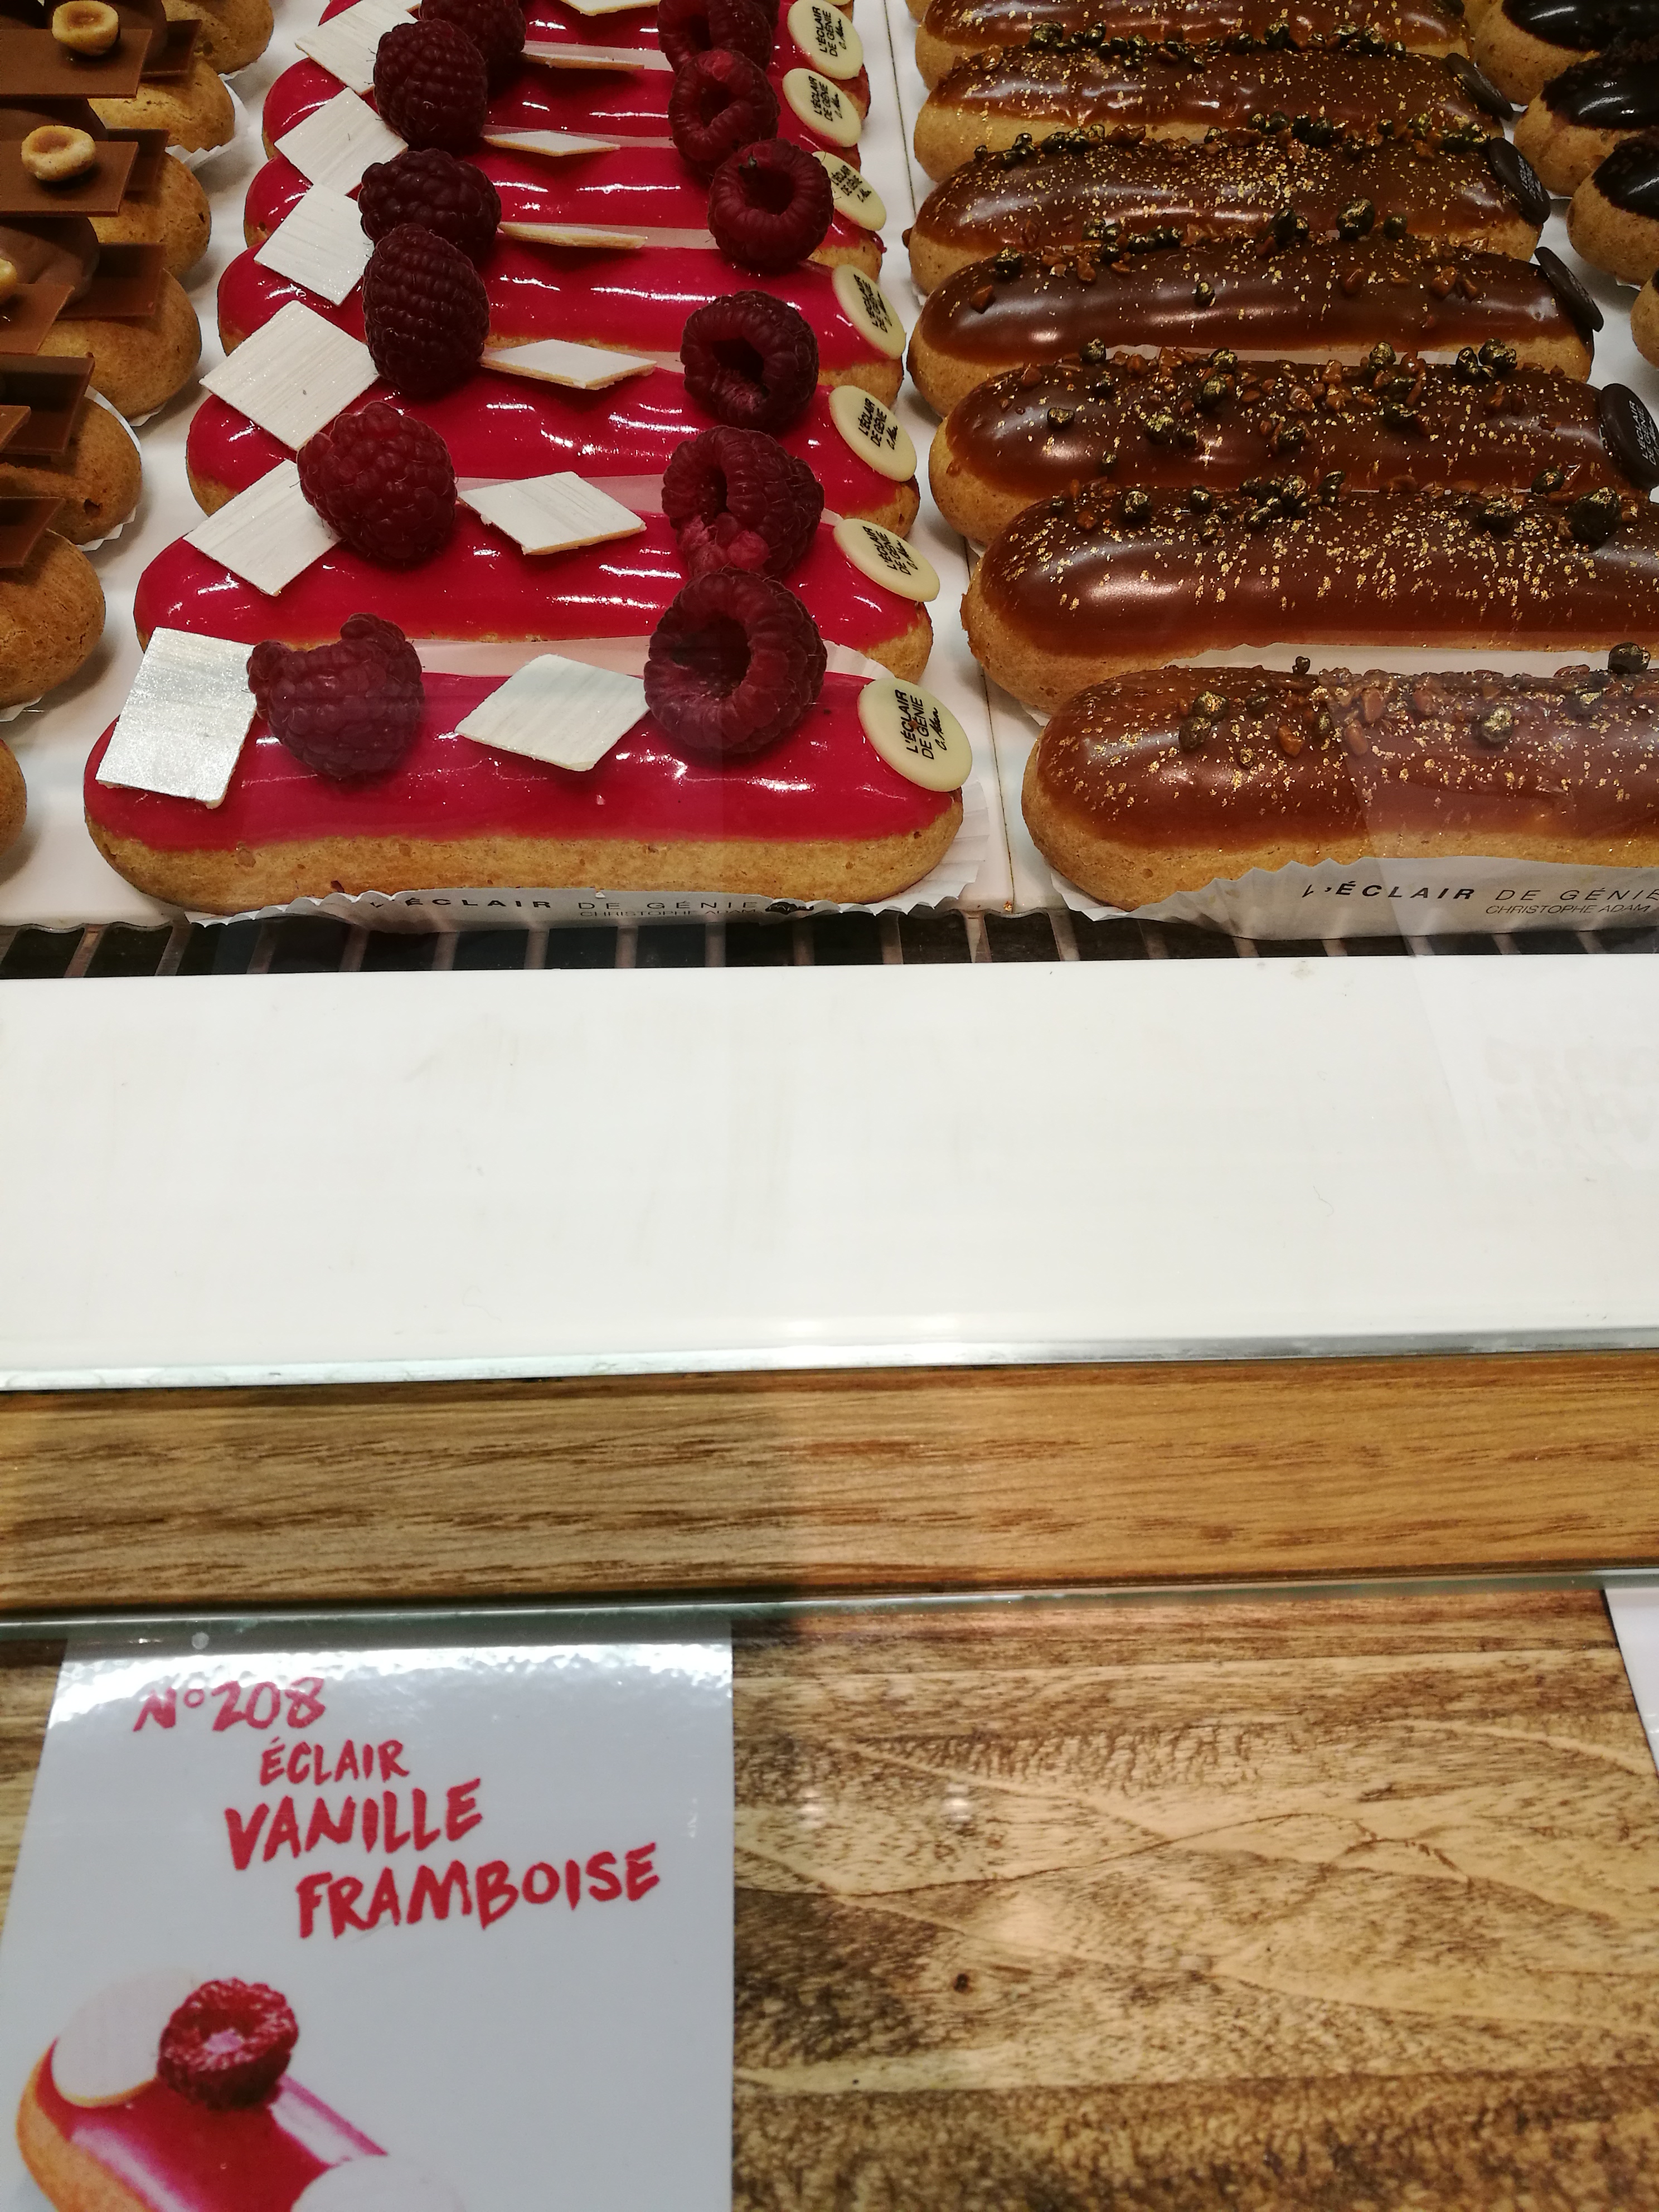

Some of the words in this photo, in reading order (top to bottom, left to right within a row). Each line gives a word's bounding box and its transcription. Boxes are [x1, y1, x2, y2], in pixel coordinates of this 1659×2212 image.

[812, 7, 827, 53] L'ÉCLAIR
[828, 42, 838, 57] DE
[823, 107, 833, 122] DE
[870, 430, 882, 447] DE
[862, 526, 898, 570] L'ÉCLAIR
[894, 560, 911, 575] DE
[894, 688, 919, 754] L'ÉCLAIR
[910, 695, 929, 737] GÉNIE
[919, 738, 934, 760] DE
[647, 900, 757, 909] GÉNIE
[1302, 881, 1475, 899] L'ÉCLAIR
[1495, 890, 1541, 900] DE
[1560, 887, 1659, 901] GÉNIE
[1486, 905, 1593, 914] CHRISTOPHE
[1598, 904, 1652, 913] ADAM
[133, 1676, 327, 1731] N°208
[259, 1736, 410, 1786] ÉCLAIR
[225, 1778, 484, 1871] VANILLE
[295, 1842, 661, 1939] FRAMBOISE
